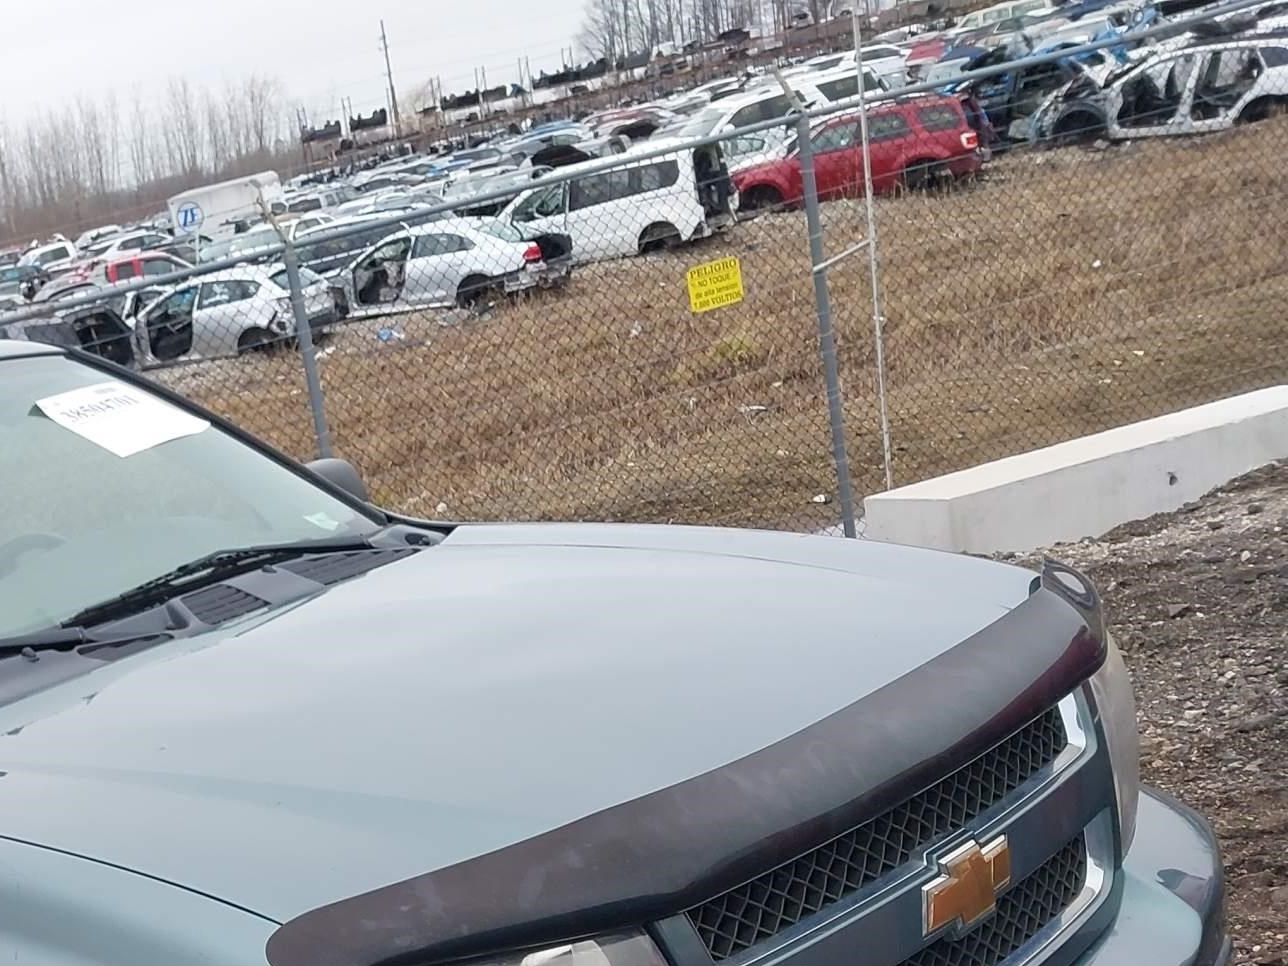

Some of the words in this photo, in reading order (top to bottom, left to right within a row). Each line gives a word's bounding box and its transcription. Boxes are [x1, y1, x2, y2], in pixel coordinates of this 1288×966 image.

[181, 207, 198, 227] ZF
[689, 259, 737, 279] PELIGRO
[697, 279, 708, 287] NO
[709, 273, 730, 285] TOQUE
